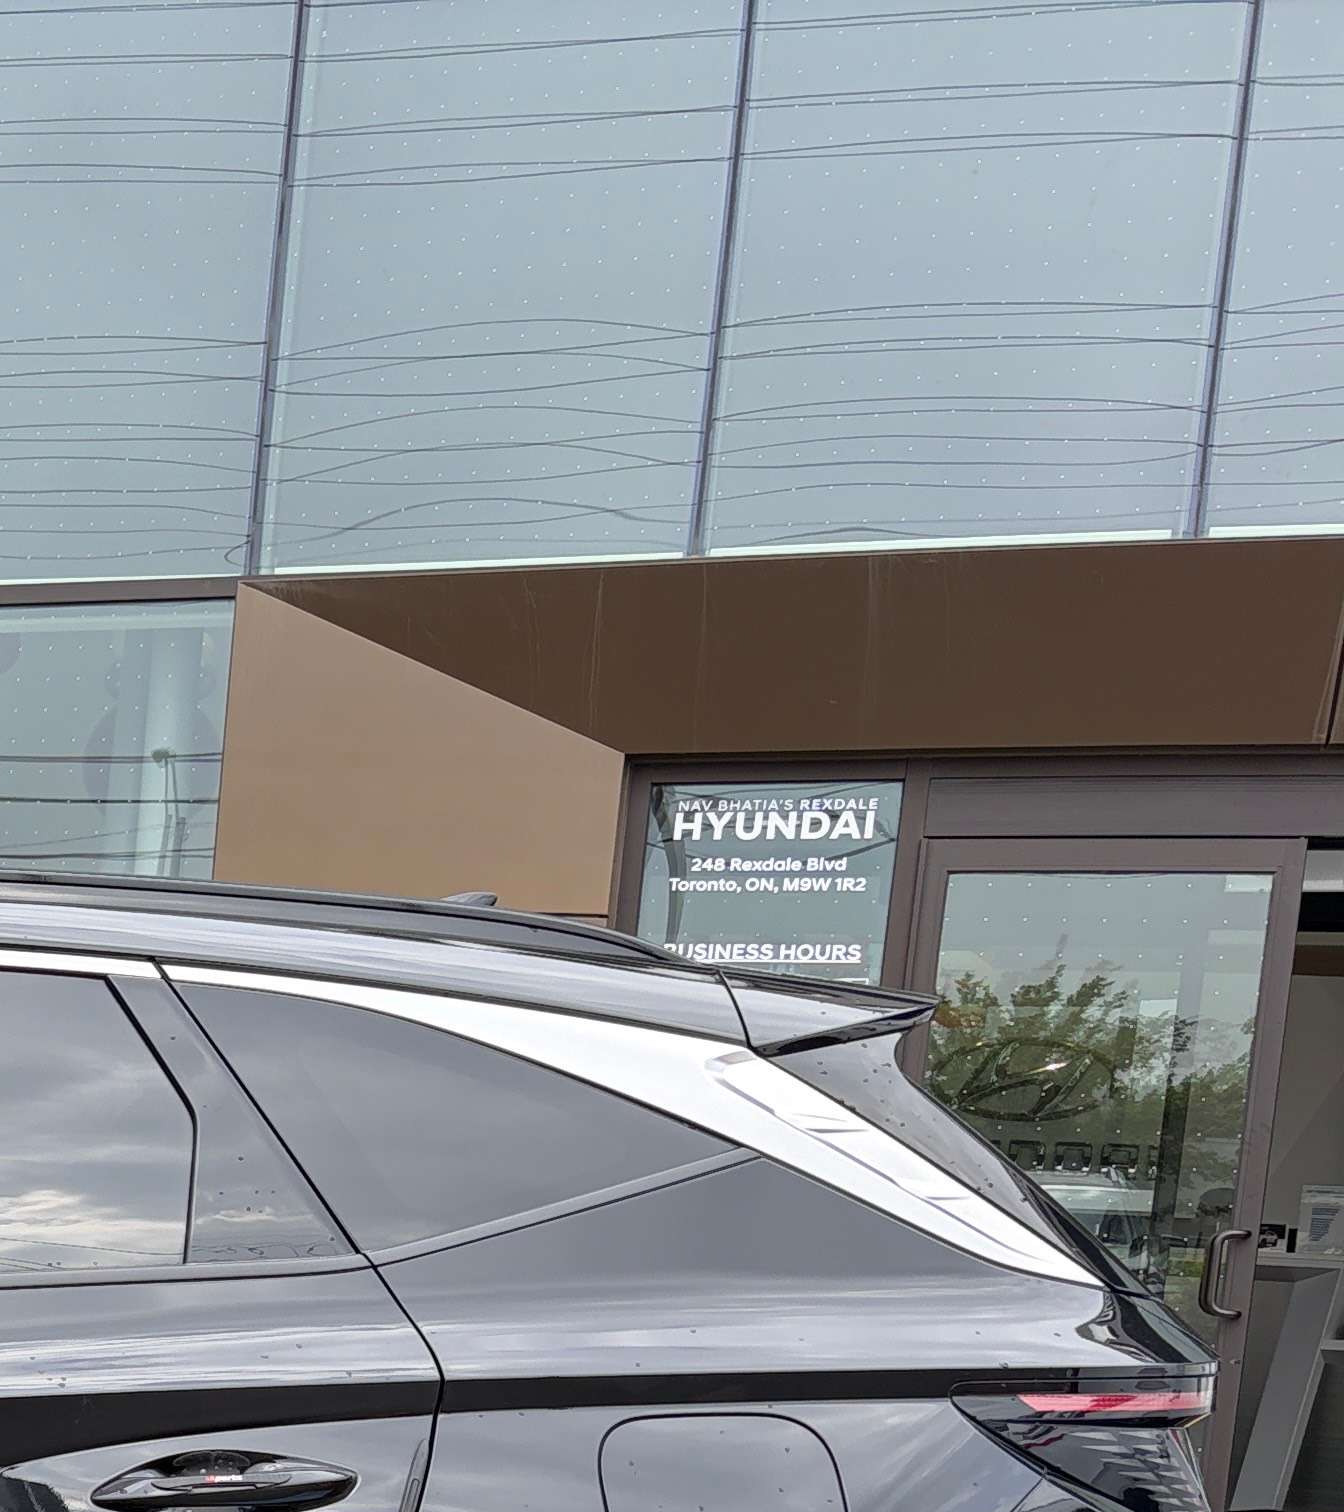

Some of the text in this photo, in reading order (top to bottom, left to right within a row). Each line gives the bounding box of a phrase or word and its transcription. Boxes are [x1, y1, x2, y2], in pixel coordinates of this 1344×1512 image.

[678, 797, 880, 812] NAV BHATIA'S REXDALE
[672, 811, 876, 841] HYUNDAI
[690, 856, 848, 872] 248 Rexdale Blvd
[669, 877, 867, 894] Toronto, ON, M9W 1R2
[779, 944, 862, 961] HOURS
